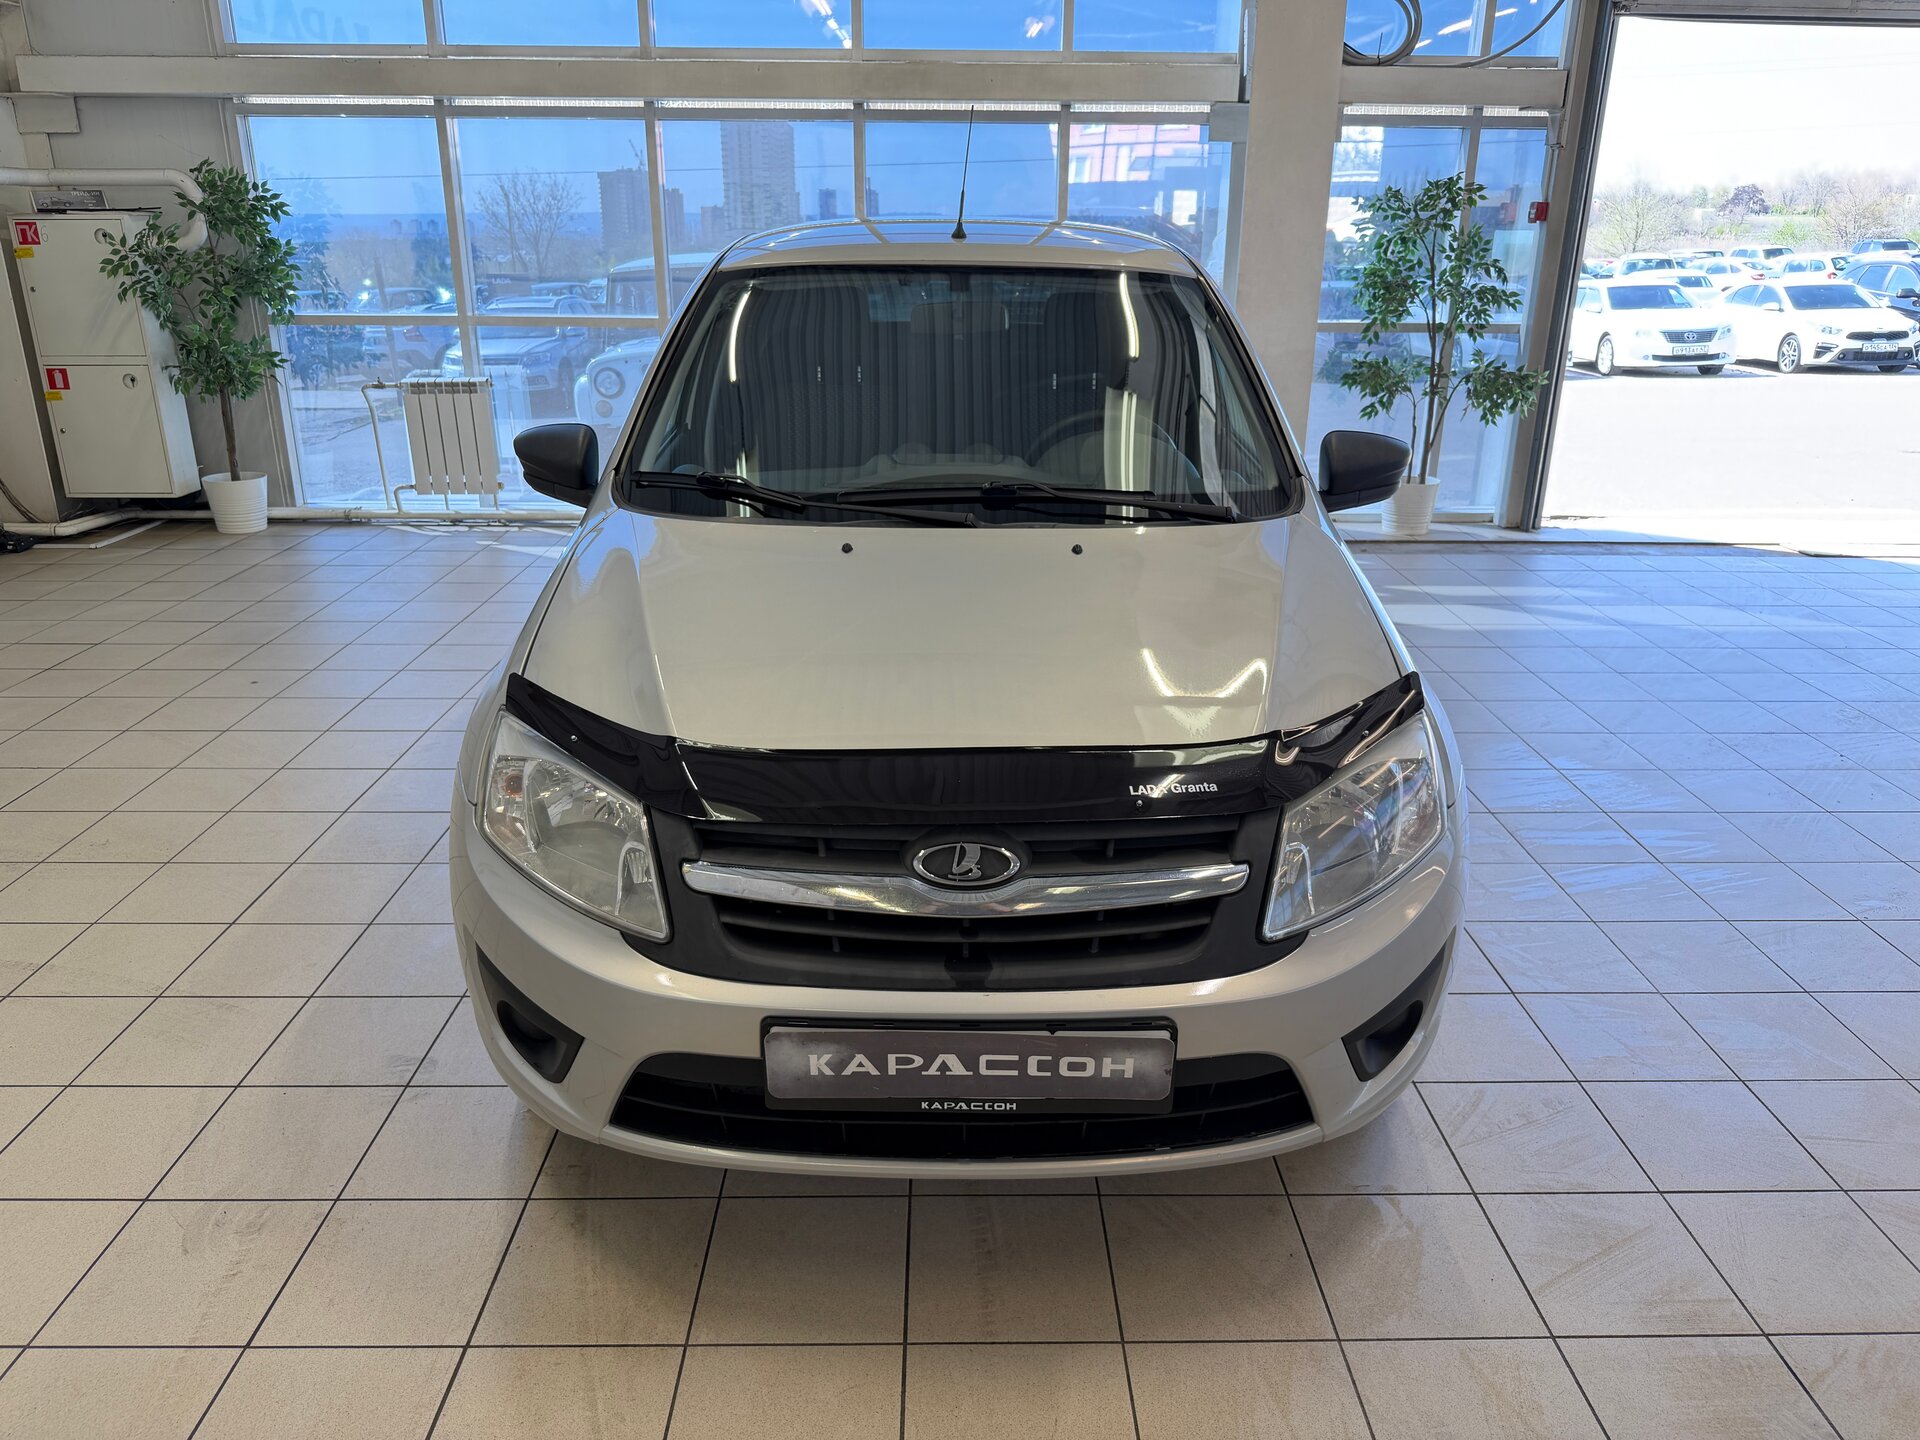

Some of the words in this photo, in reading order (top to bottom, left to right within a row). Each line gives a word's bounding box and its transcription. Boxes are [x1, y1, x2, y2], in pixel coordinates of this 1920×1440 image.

[16, 224, 39, 242] ПК
[1171, 782, 1218, 793] Granta
[808, 1053, 1134, 1079] КАРАССОН
[921, 1101, 1017, 1111] КАРАССОН
